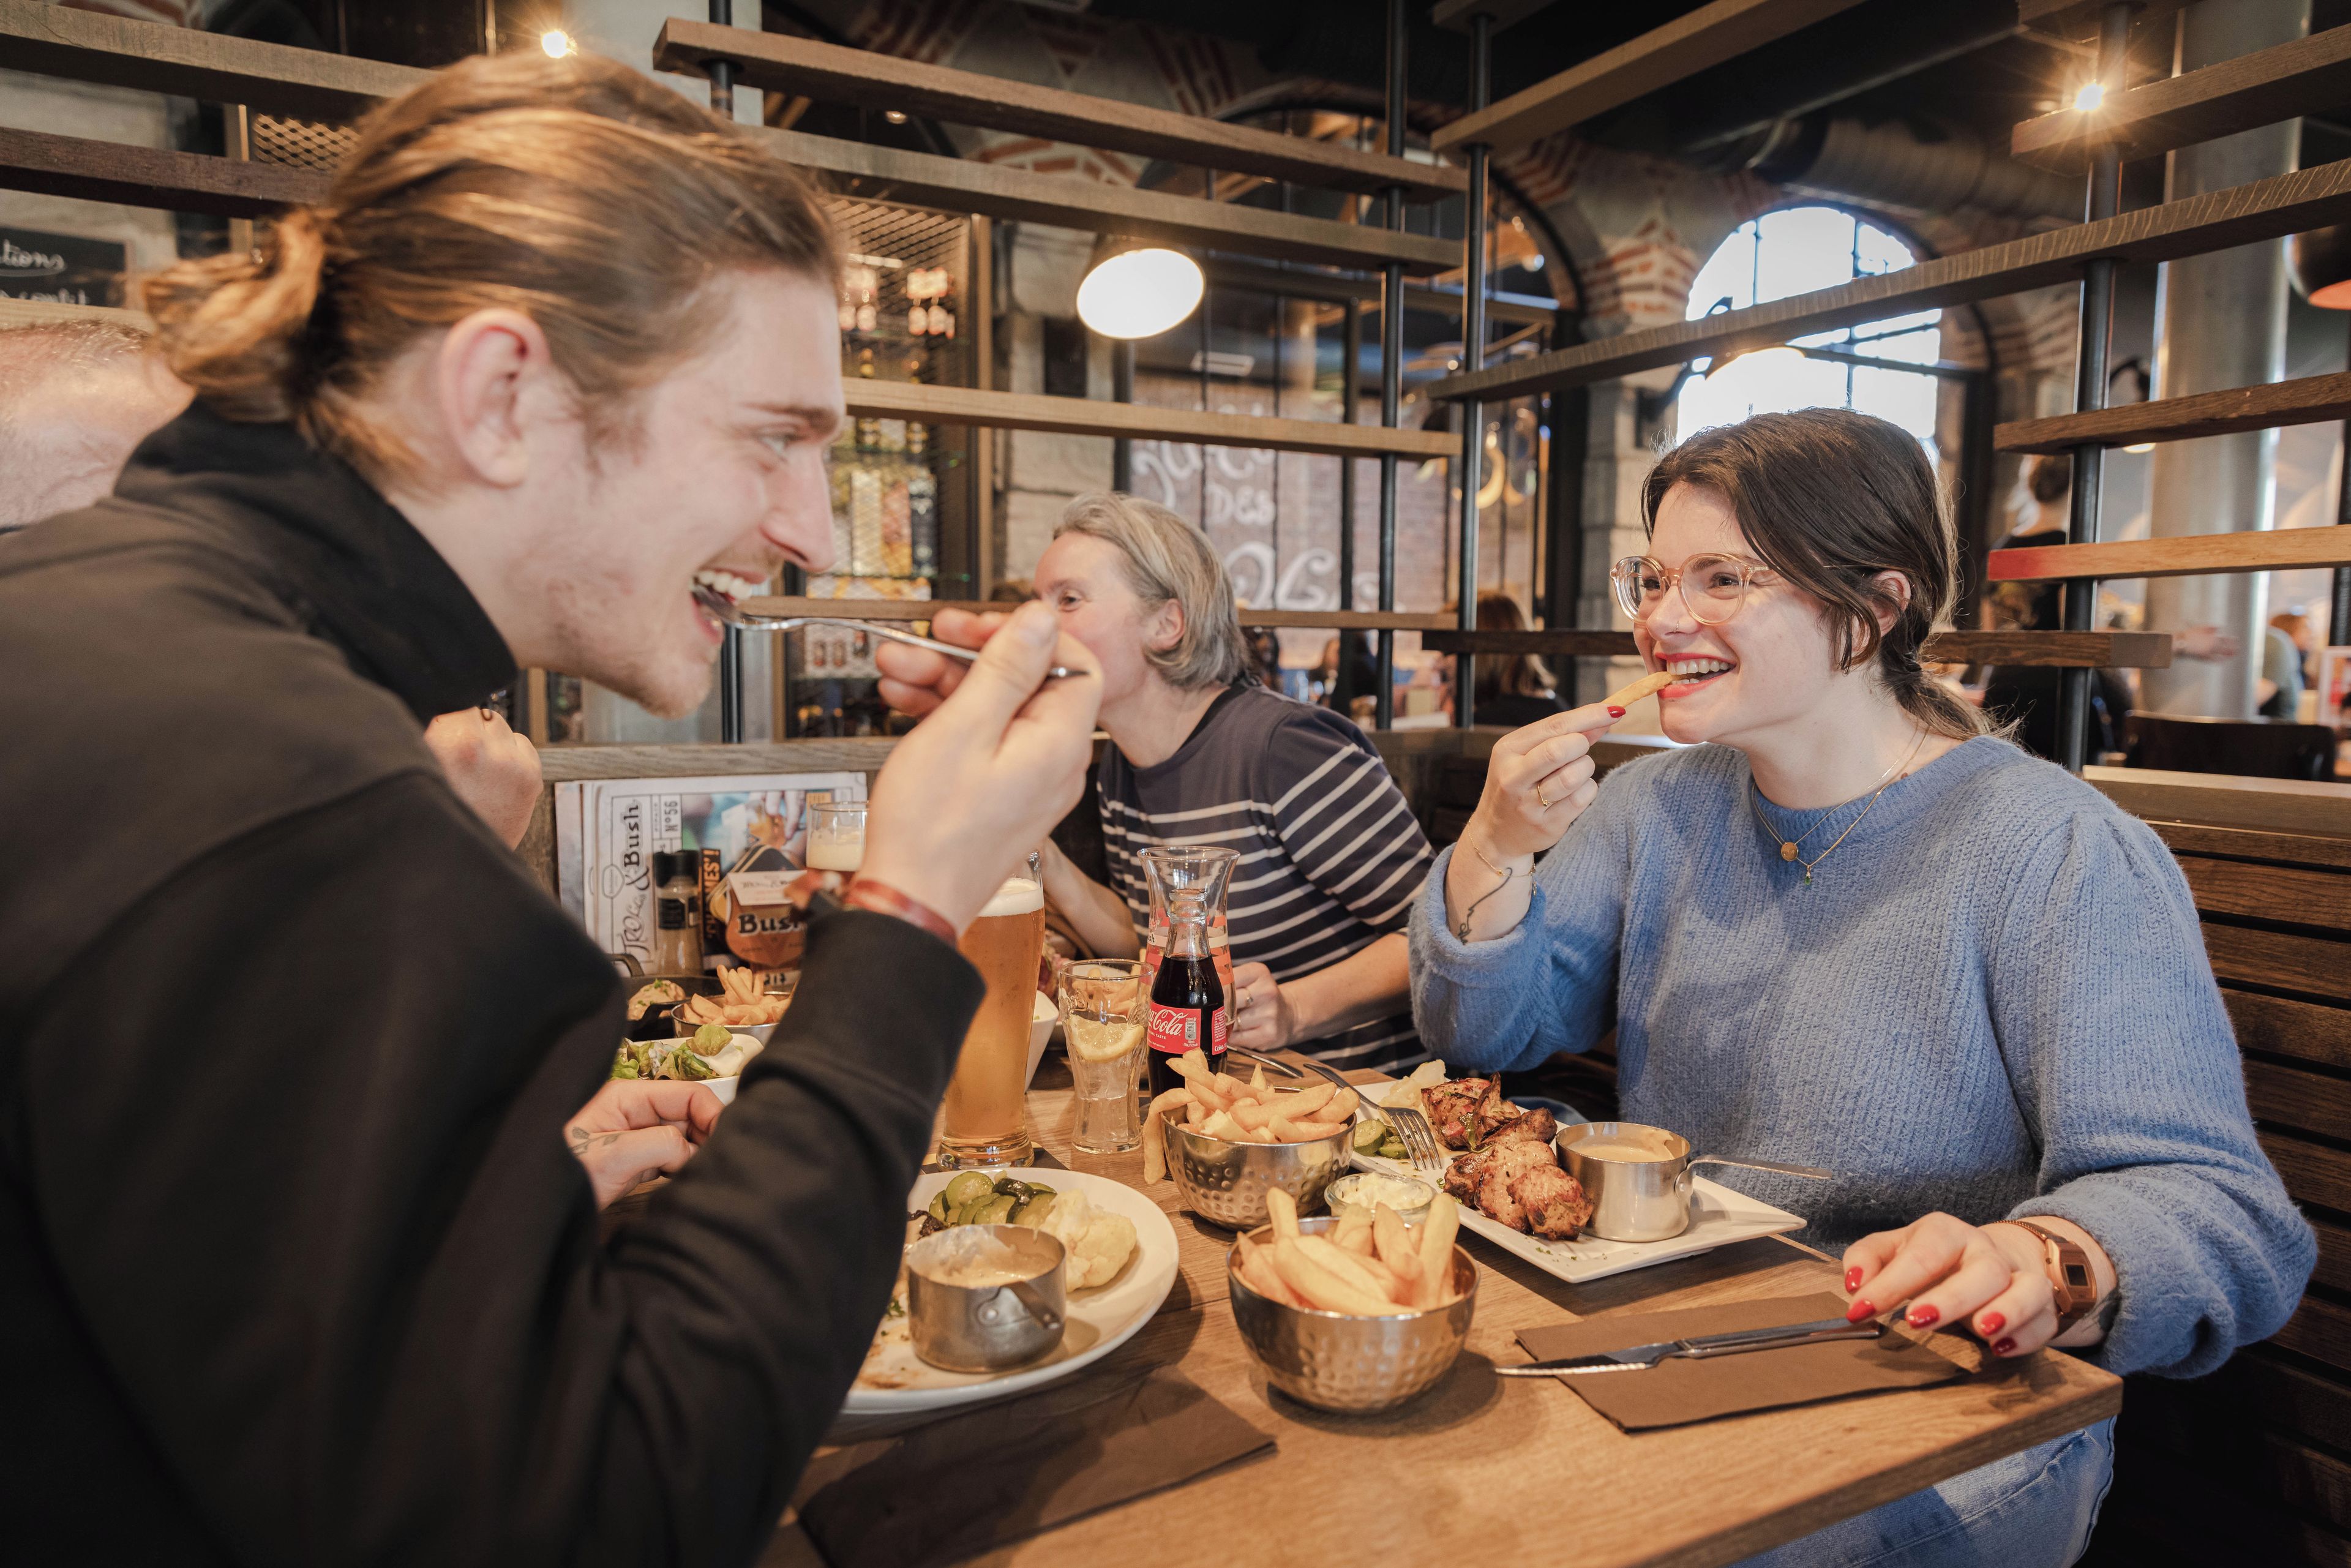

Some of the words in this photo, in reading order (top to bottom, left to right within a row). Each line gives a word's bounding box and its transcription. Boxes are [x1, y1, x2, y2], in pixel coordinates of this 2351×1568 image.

[0, 238, 67, 271] tions
[623, 805, 640, 868] Bush
[738, 914, 798, 934] Bus
